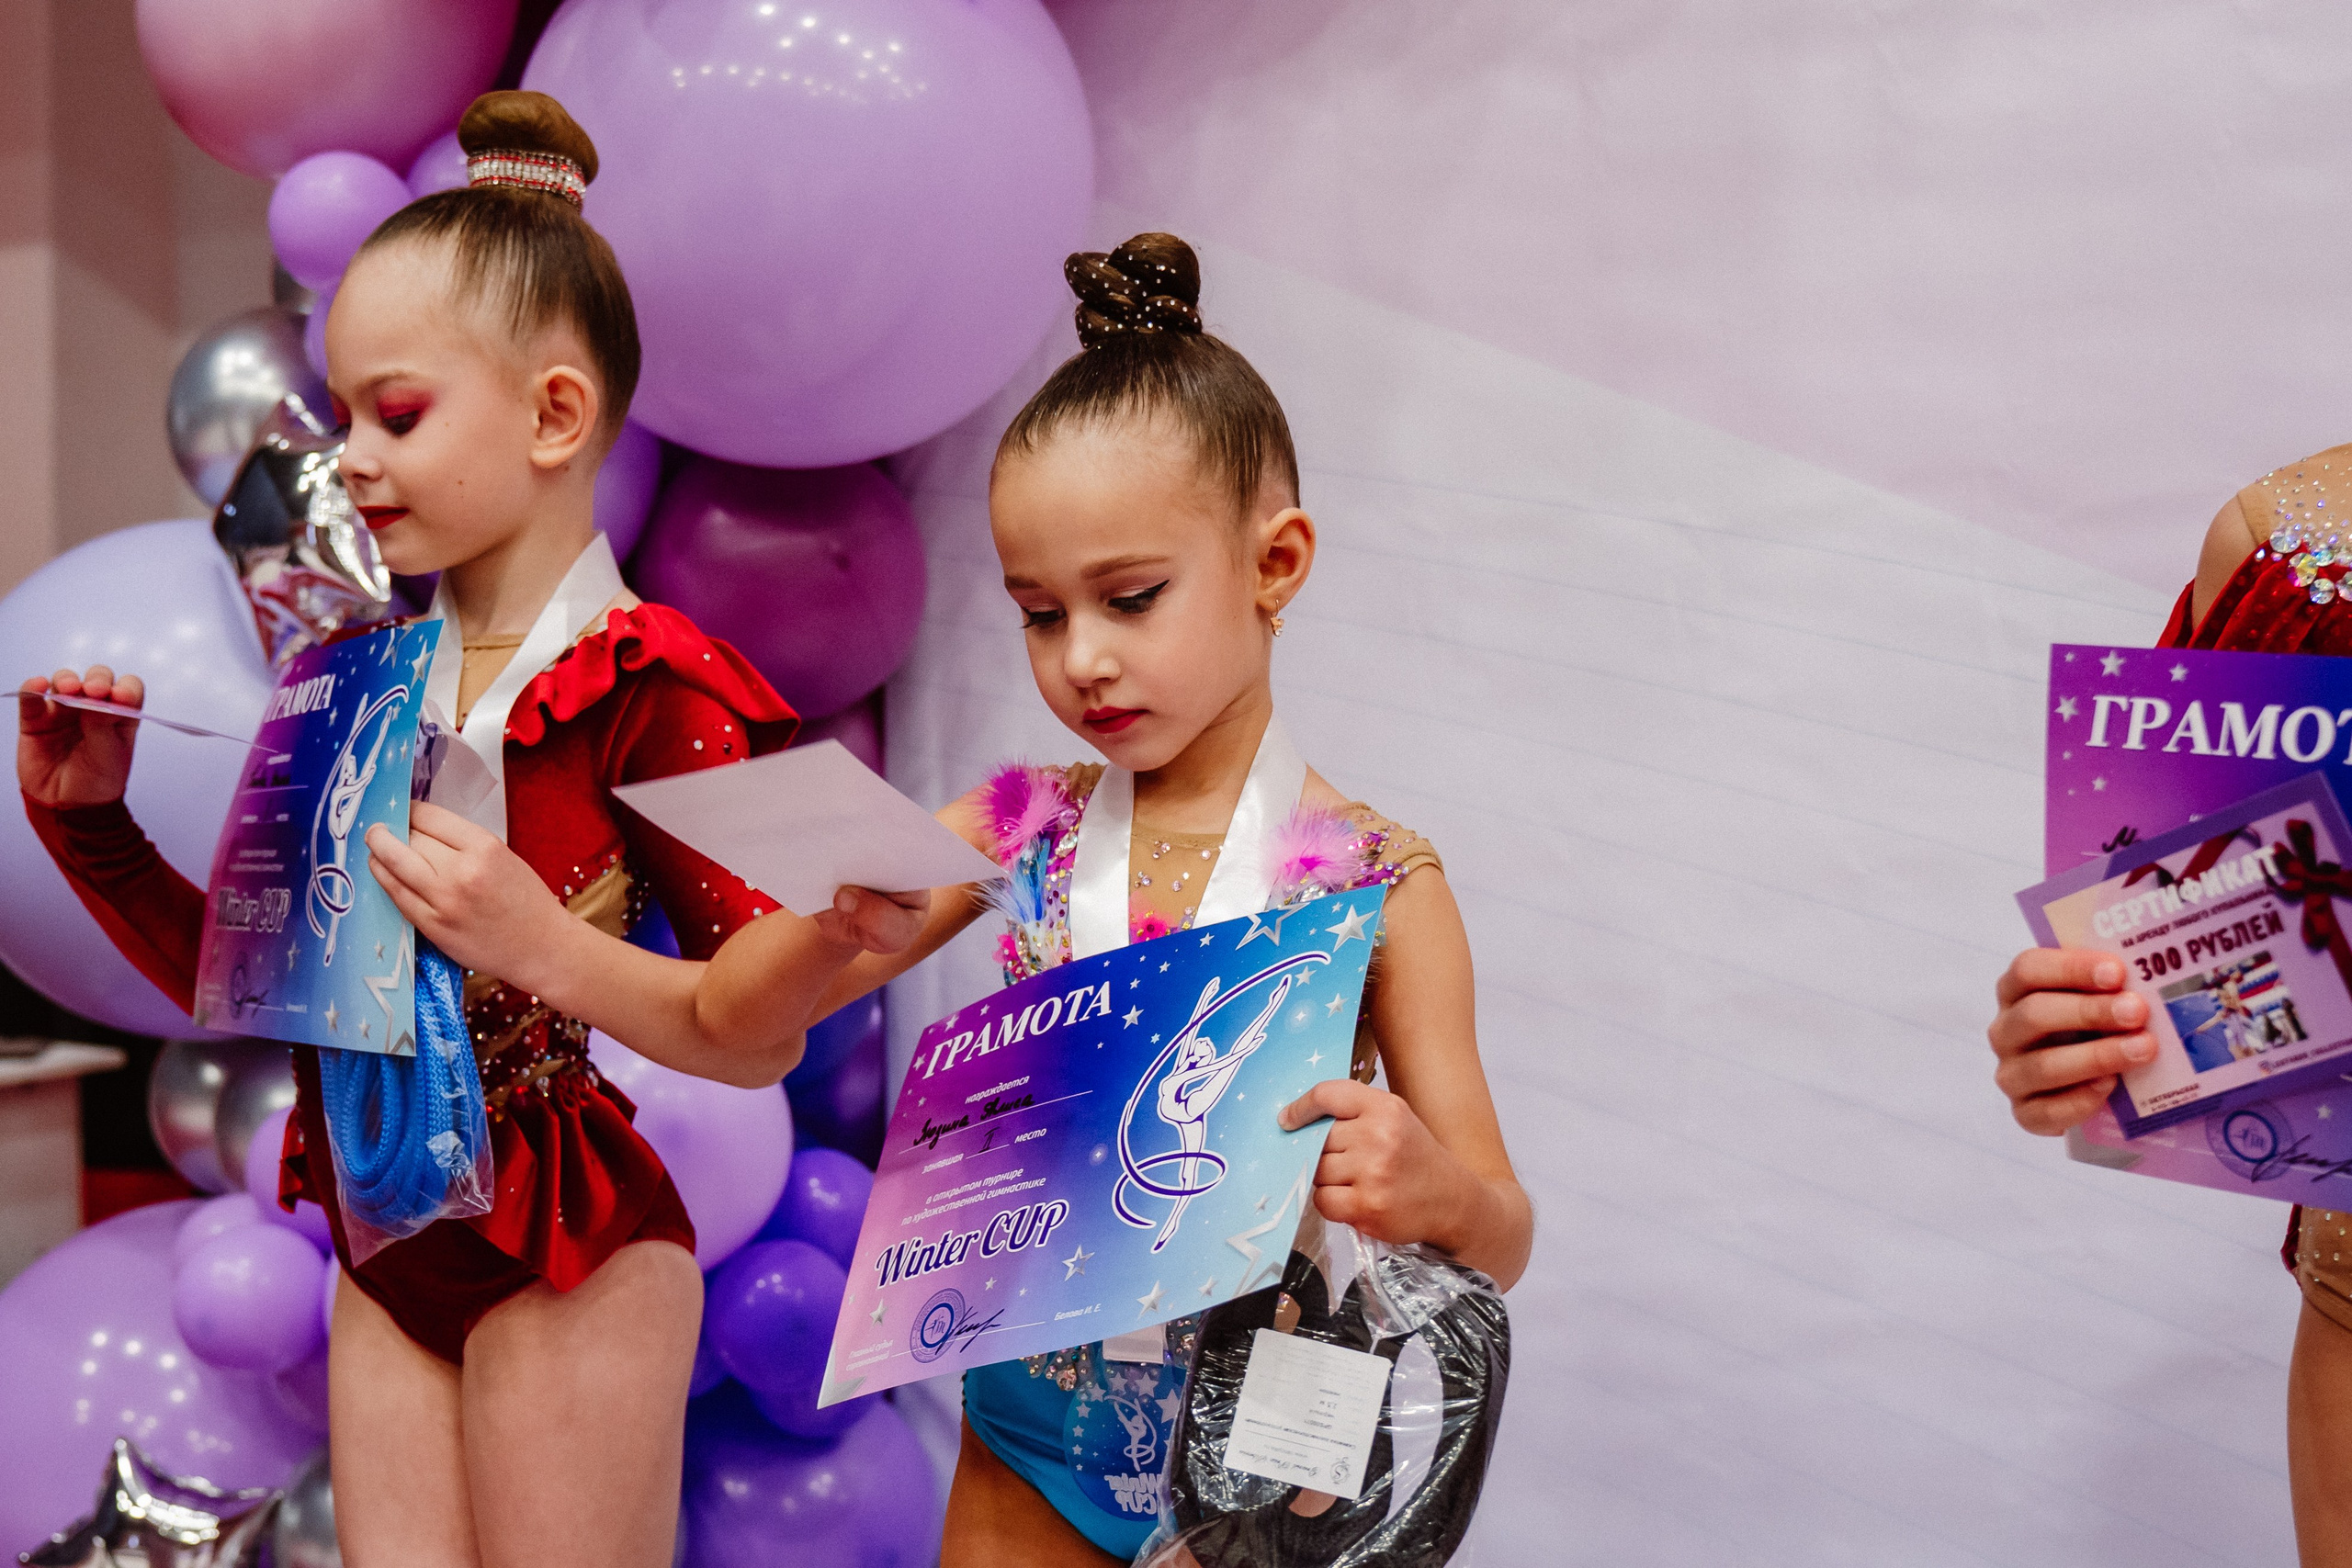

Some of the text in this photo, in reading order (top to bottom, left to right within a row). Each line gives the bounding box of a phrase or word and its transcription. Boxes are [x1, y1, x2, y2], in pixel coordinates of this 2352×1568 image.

[256, 887, 292, 933] CUP
[2092, 846, 2278, 939] СЕРТИФИКАТ
[2134, 901, 2285, 982] 300 РУБЛЕЙ
[922, 980, 1113, 1080] ГРАМОТА
[965, 1076, 1030, 1105] награждается
[922, 1153, 965, 1175] занявшая
[1014, 1128, 1047, 1145] место
[901, 1177, 1046, 1226] по художественной гимнастике
[933, 1180, 982, 1201] открытом
[982, 1168, 1024, 1187] турнире
[875, 1198, 1070, 1290] Winter CUP
